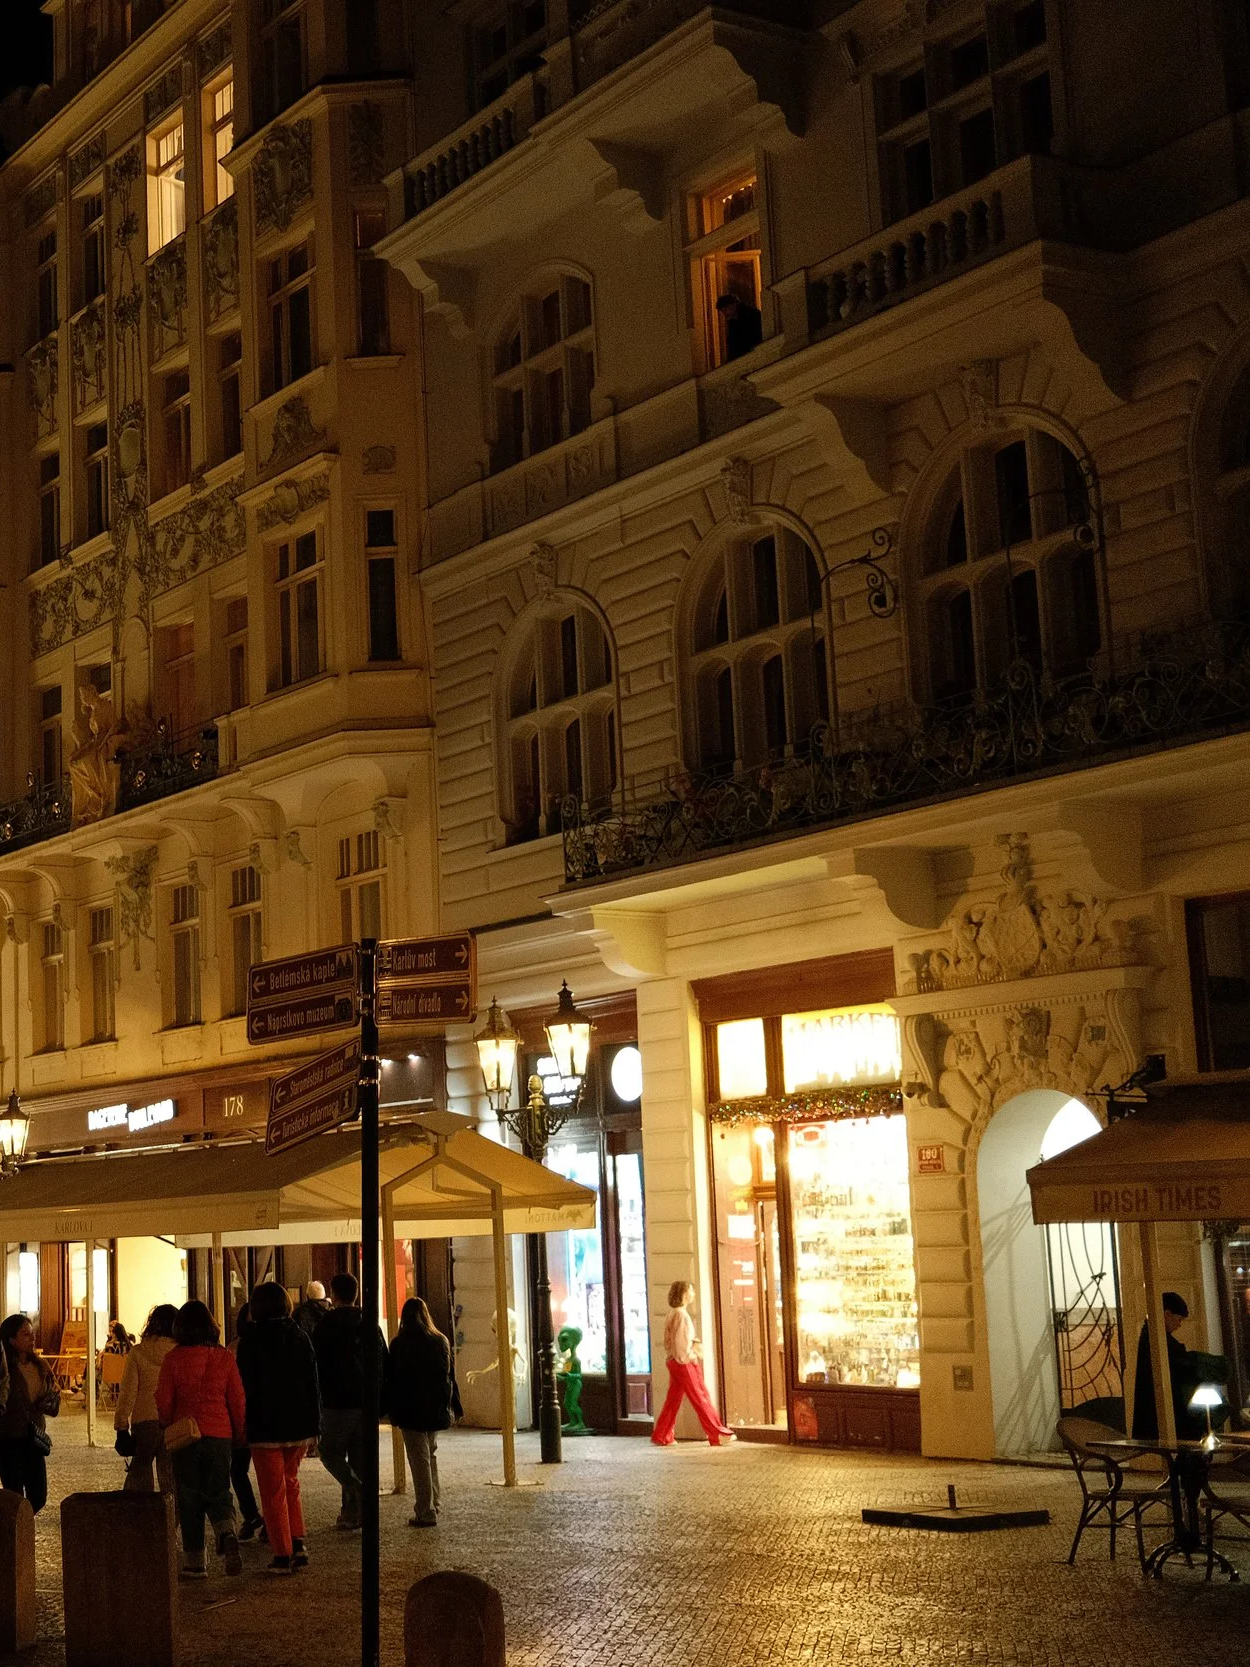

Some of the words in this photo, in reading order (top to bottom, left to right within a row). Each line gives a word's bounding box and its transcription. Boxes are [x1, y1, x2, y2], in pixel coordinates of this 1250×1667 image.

[417, 947, 437, 969] most
[270, 963, 311, 990] Betlémská
[312, 960, 336, 983] kaple
[267, 1009, 305, 1034] Náprstkovo
[306, 1004, 335, 1024] muzeum
[224, 1095, 244, 1117] 178
[1093, 1188, 1149, 1213] IRISH
[1155, 1186, 1222, 1212] TIMES
[55, 1220, 88, 1235] KARLOVA
